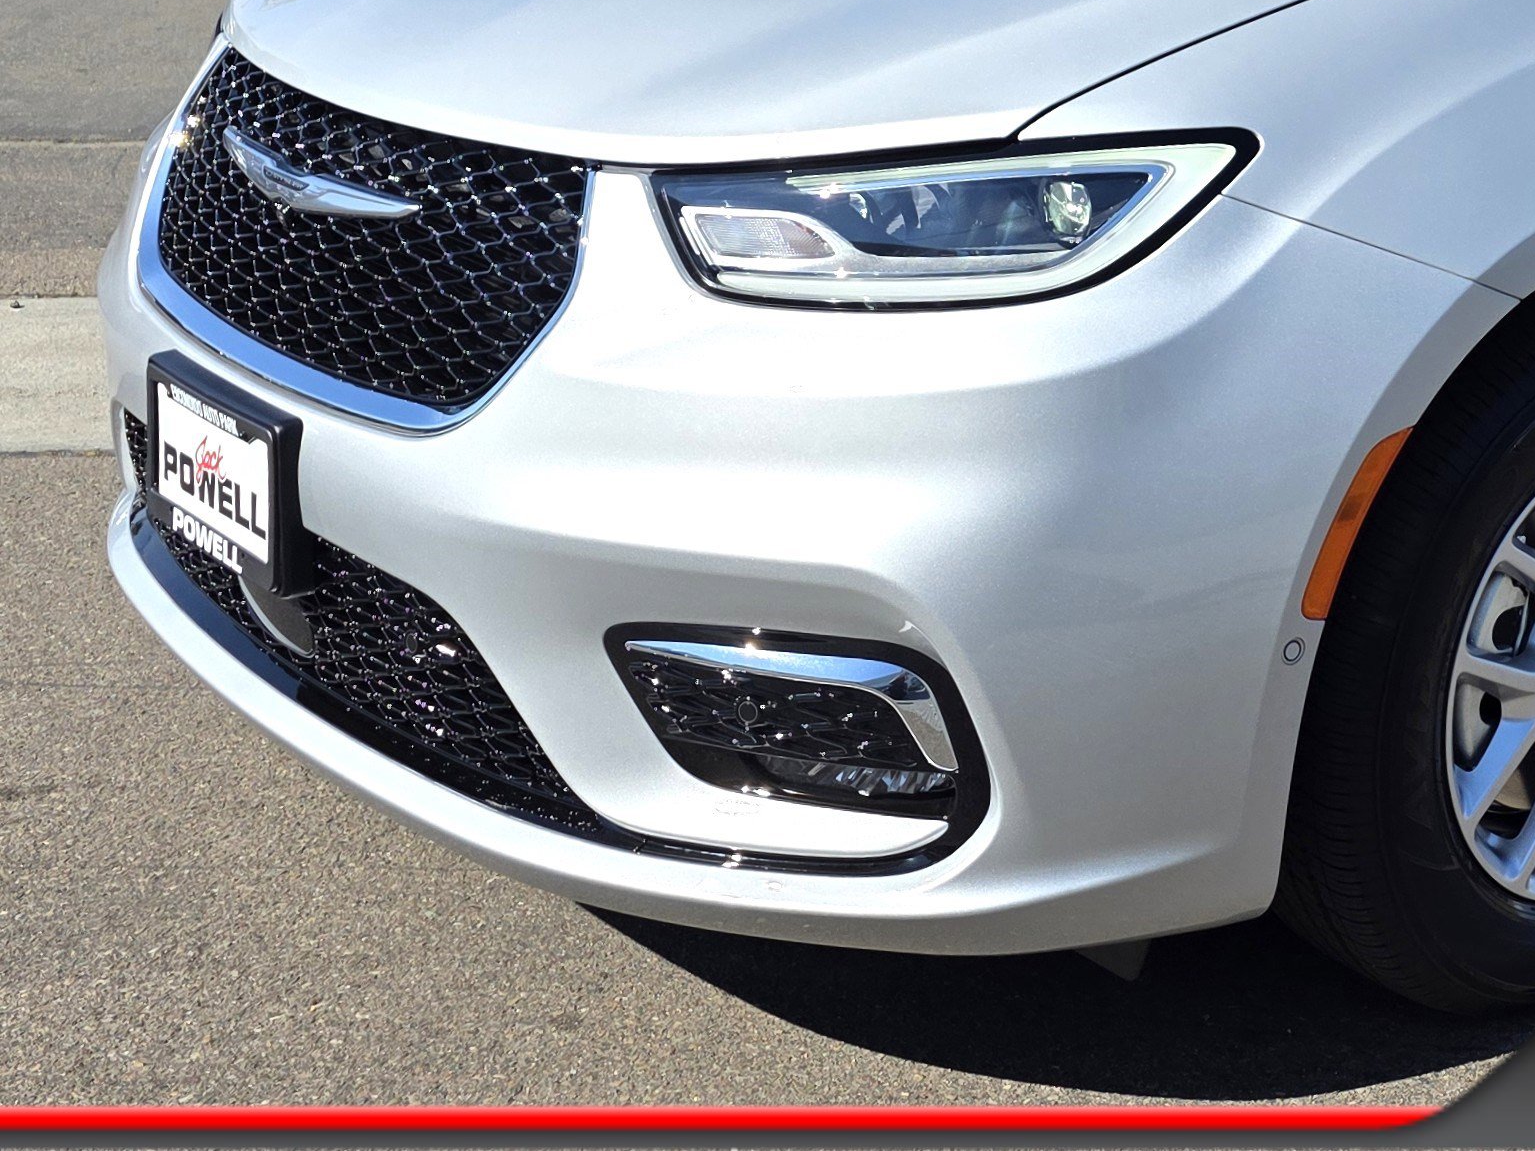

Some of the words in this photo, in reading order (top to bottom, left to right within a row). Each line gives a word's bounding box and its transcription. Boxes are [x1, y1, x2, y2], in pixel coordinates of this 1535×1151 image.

[163, 439, 268, 541] POWELL
[195, 435, 226, 483] Jack
[172, 506, 243, 575] POWELL
